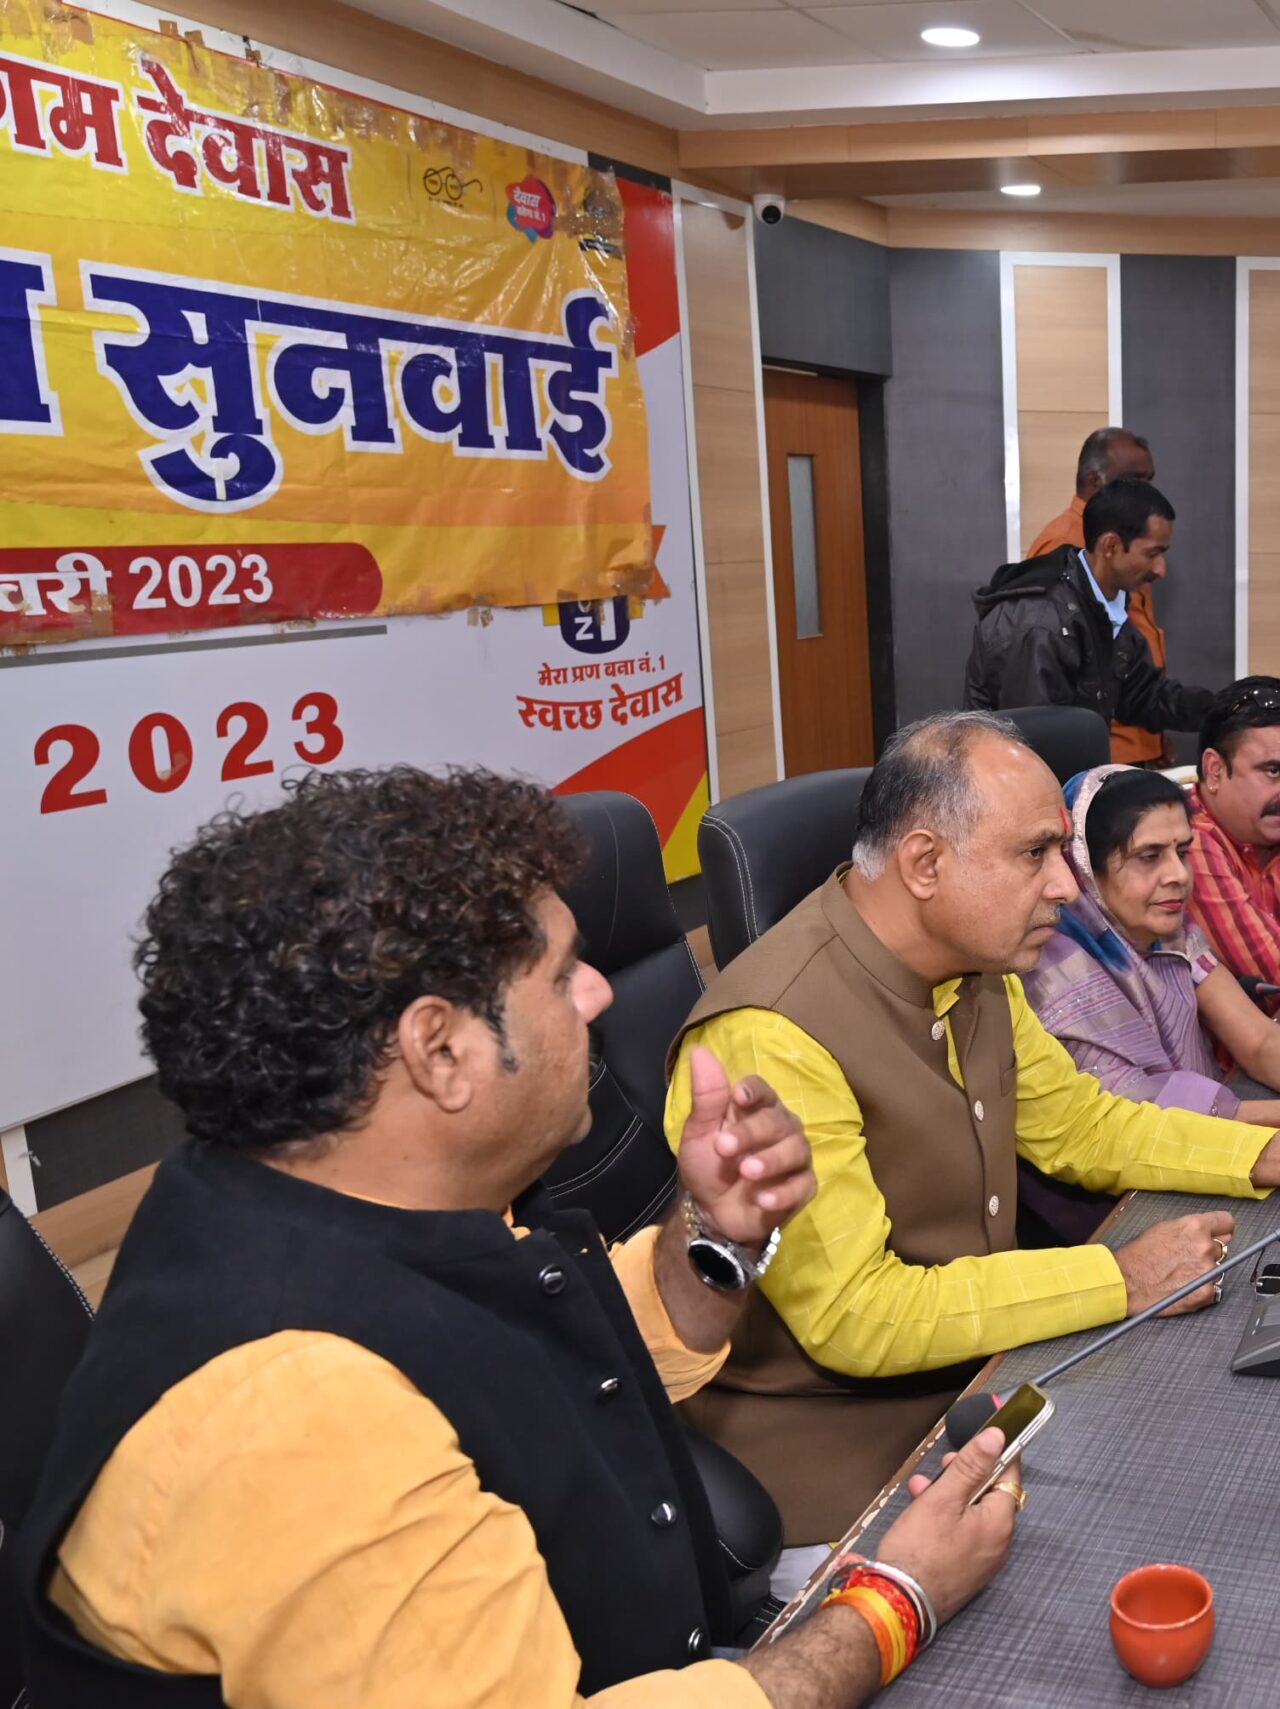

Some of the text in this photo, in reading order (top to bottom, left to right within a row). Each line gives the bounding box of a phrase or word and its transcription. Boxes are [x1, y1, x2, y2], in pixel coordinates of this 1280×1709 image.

[136, 55, 352, 220] देवास
[89, 273, 612, 502] सुनवाई
[128, 554, 274, 610] 2023
[516, 672, 683, 731] स्वच्छ देवास
[538, 662, 568, 686] मेरा
[572, 663, 600, 683] प्रण
[638, 651, 656, 673] नं.
[659, 654, 665, 671] 1
[34, 692, 344, 814] 2023
